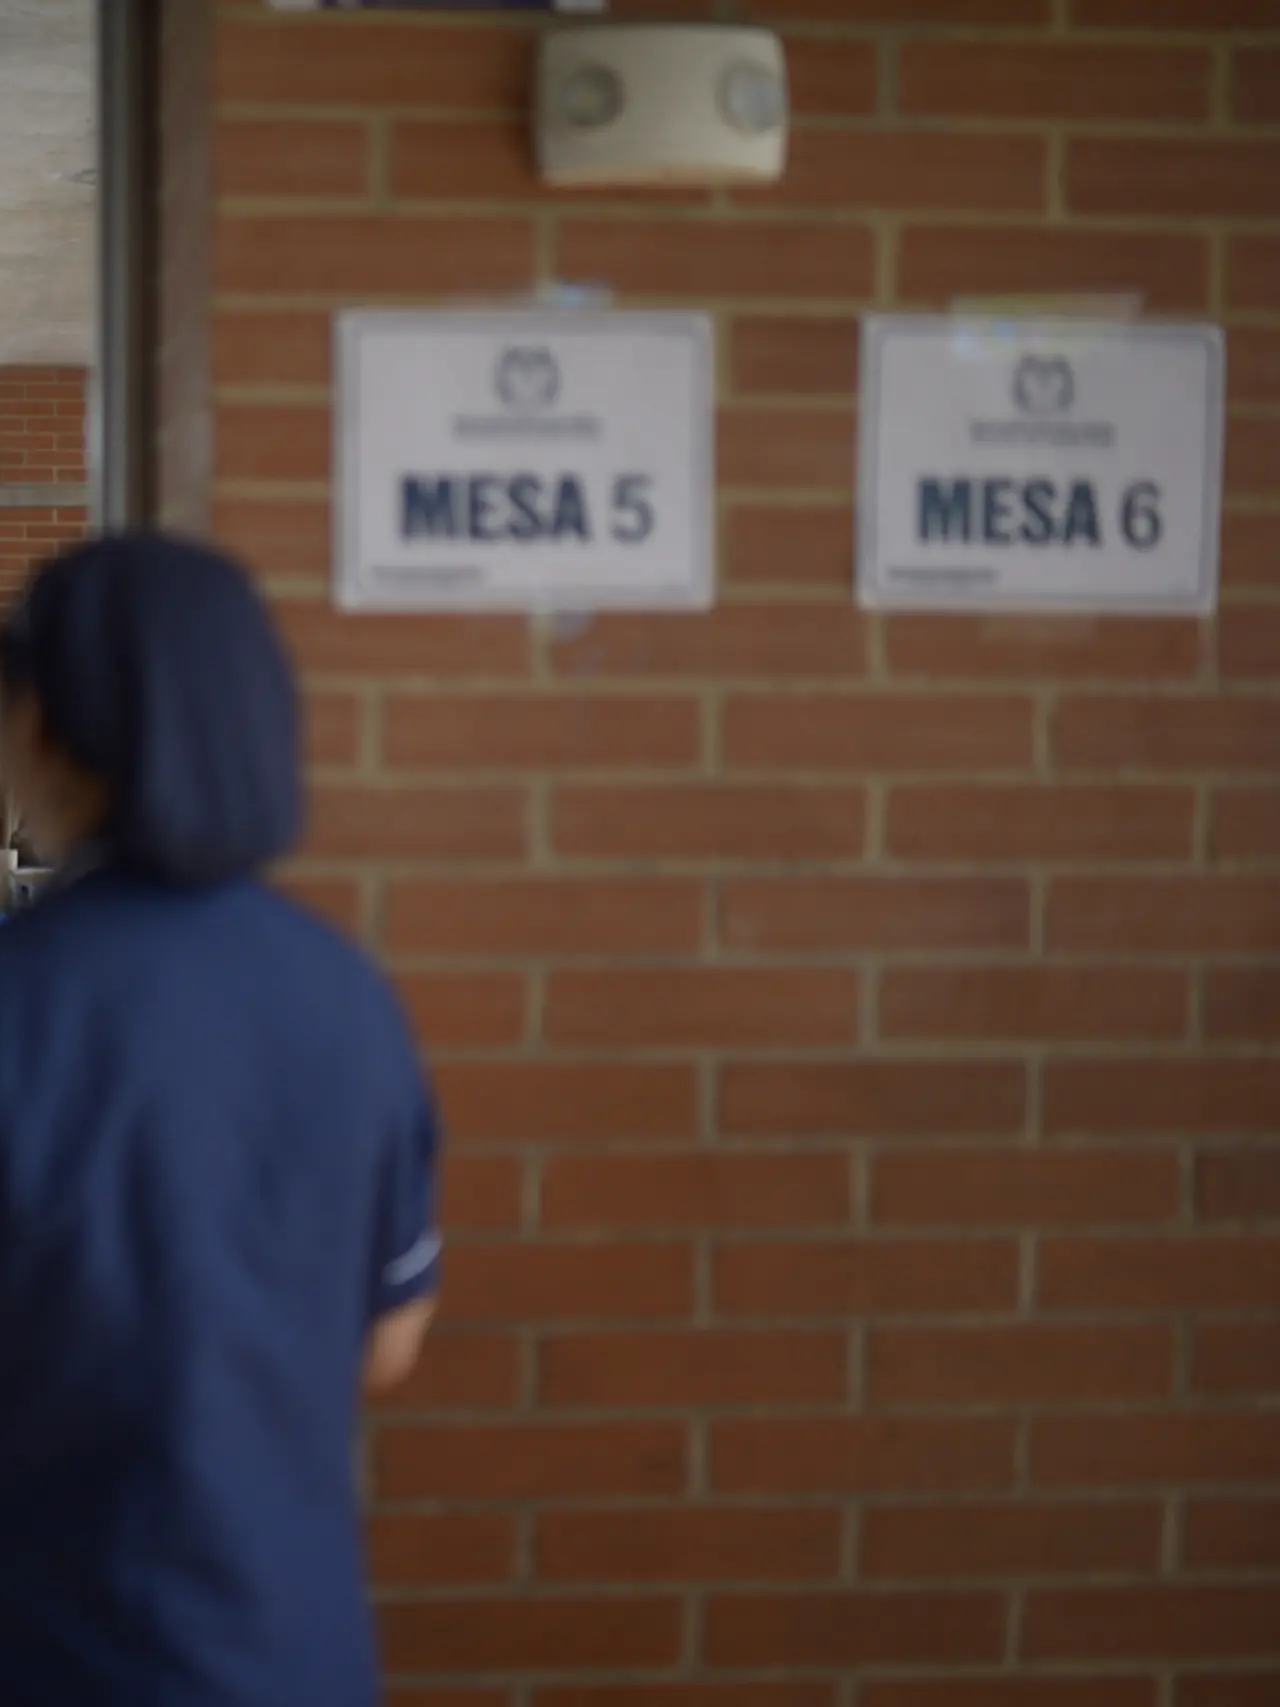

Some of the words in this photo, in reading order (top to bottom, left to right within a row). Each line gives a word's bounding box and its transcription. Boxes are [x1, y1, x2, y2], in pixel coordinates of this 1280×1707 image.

[399, 473, 589, 541] MESA
[609, 473, 656, 542] 5
[917, 478, 1101, 546] MESA
[1118, 481, 1163, 549] 6
